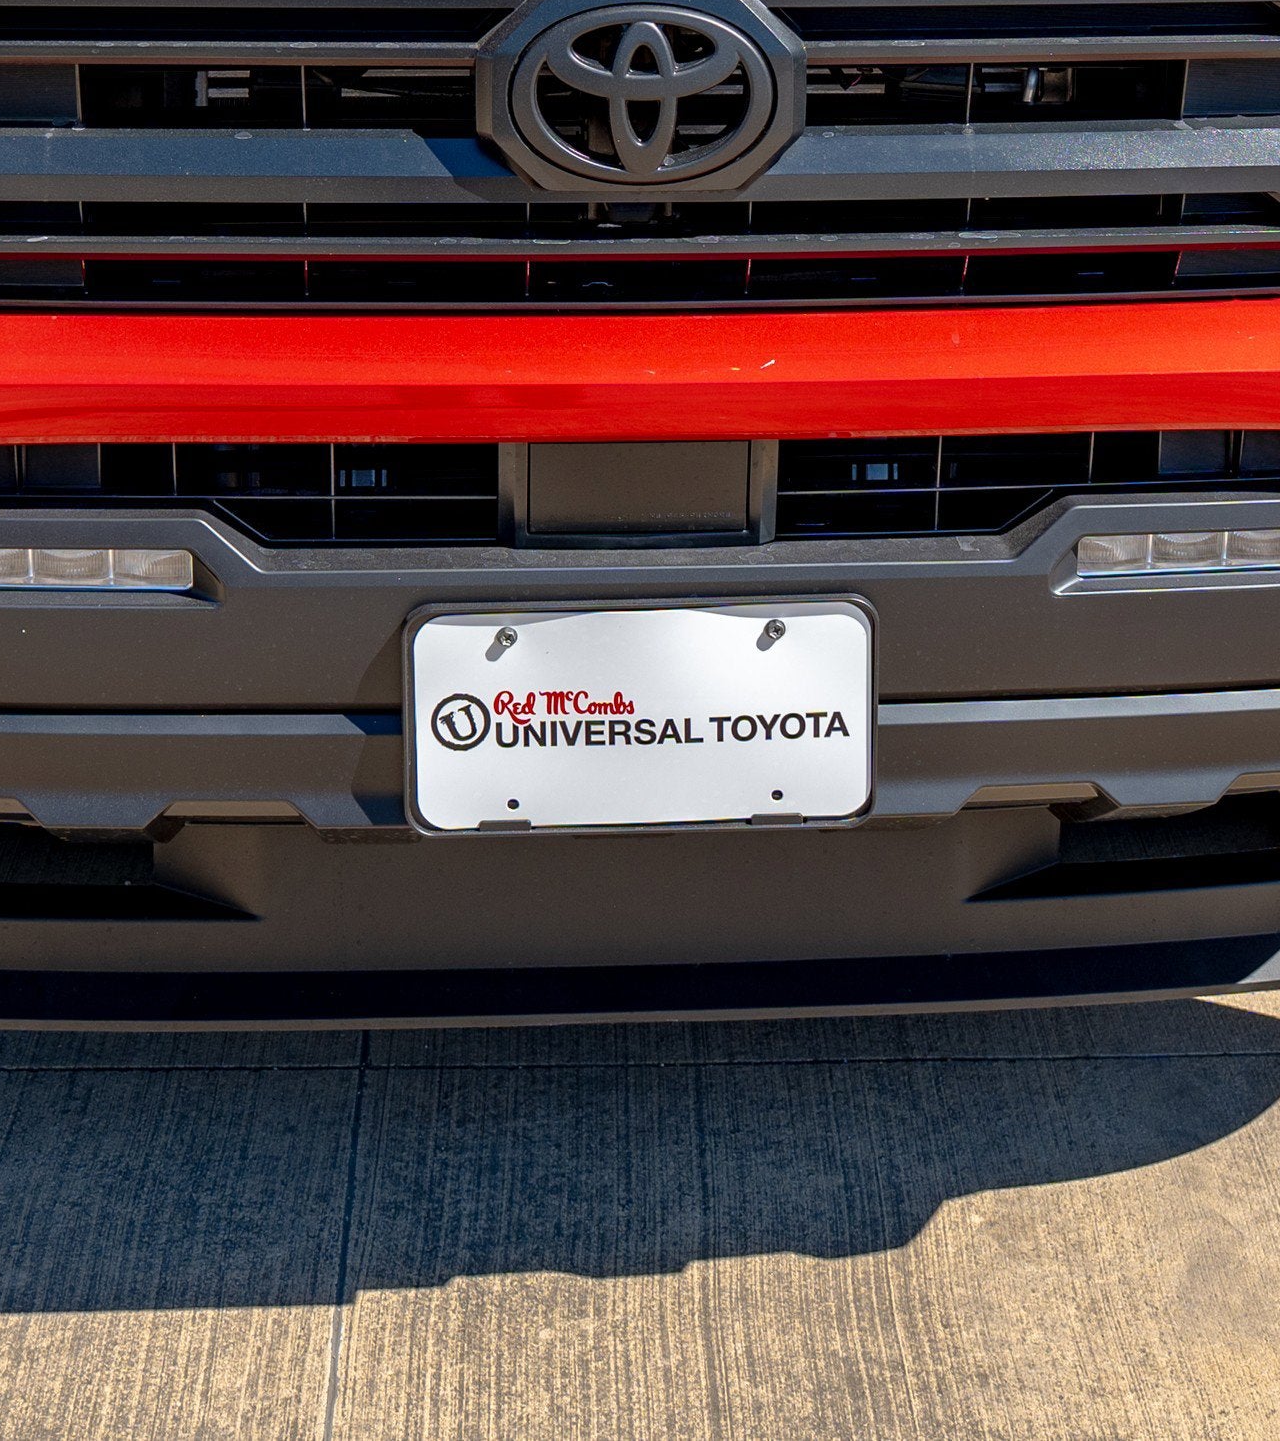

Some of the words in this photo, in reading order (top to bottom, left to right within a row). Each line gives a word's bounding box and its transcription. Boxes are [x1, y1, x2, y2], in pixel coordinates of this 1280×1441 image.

[493, 690, 536, 726] Red
[539, 690, 635, 716] McCombs
[495, 717, 704, 748] UNIVERSAL
[709, 711, 850, 743] TOYOTA
